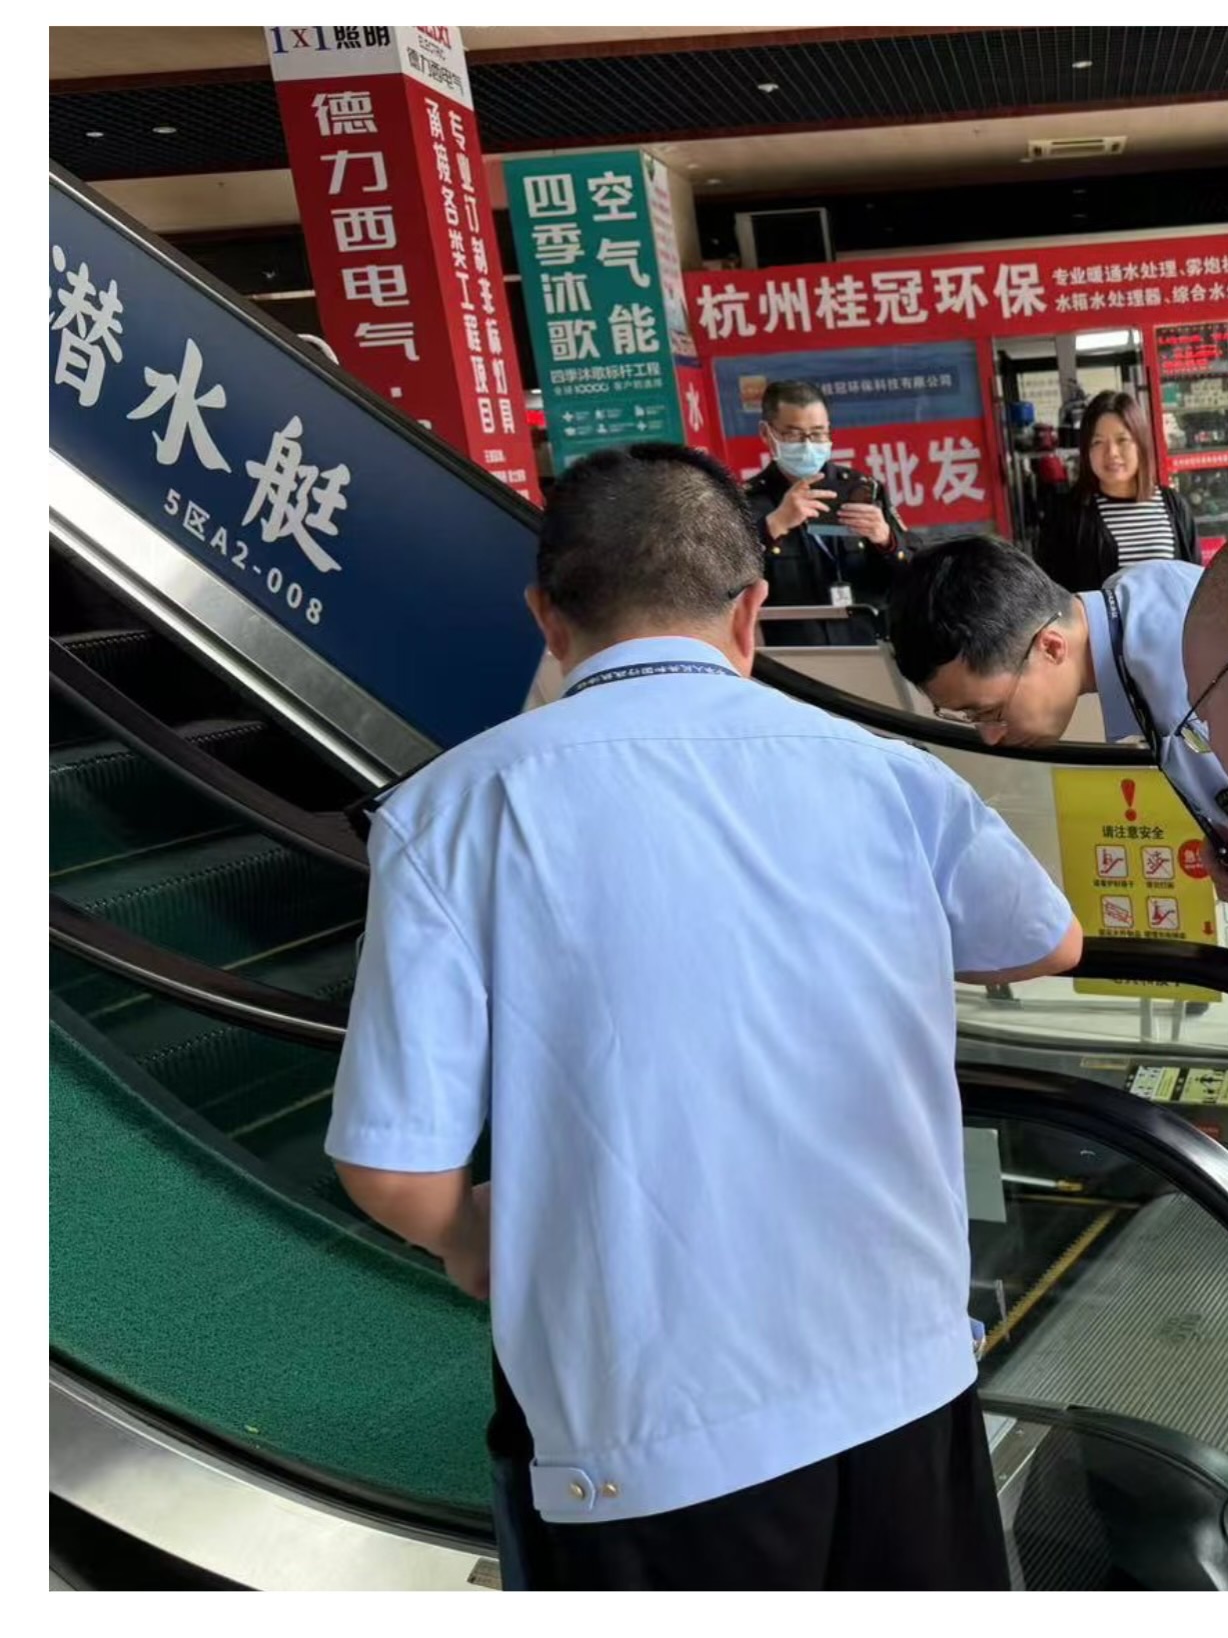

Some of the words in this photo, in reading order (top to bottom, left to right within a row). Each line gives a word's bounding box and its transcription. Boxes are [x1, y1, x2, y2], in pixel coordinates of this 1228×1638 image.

[311, 90, 420, 362] 德力西电气
[424, 97, 496, 435] 承接各类工程项目
[523, 173, 601, 362] 四季沐歌
[588, 169, 661, 356] 空气能
[697, 263, 1048, 340] 杭州桂冠环保
[48, 244, 354, 573] 潜水艇
[162, 487, 325, 626] 5区A2-008
[1102, 825, 1165, 840] 请注意安全
